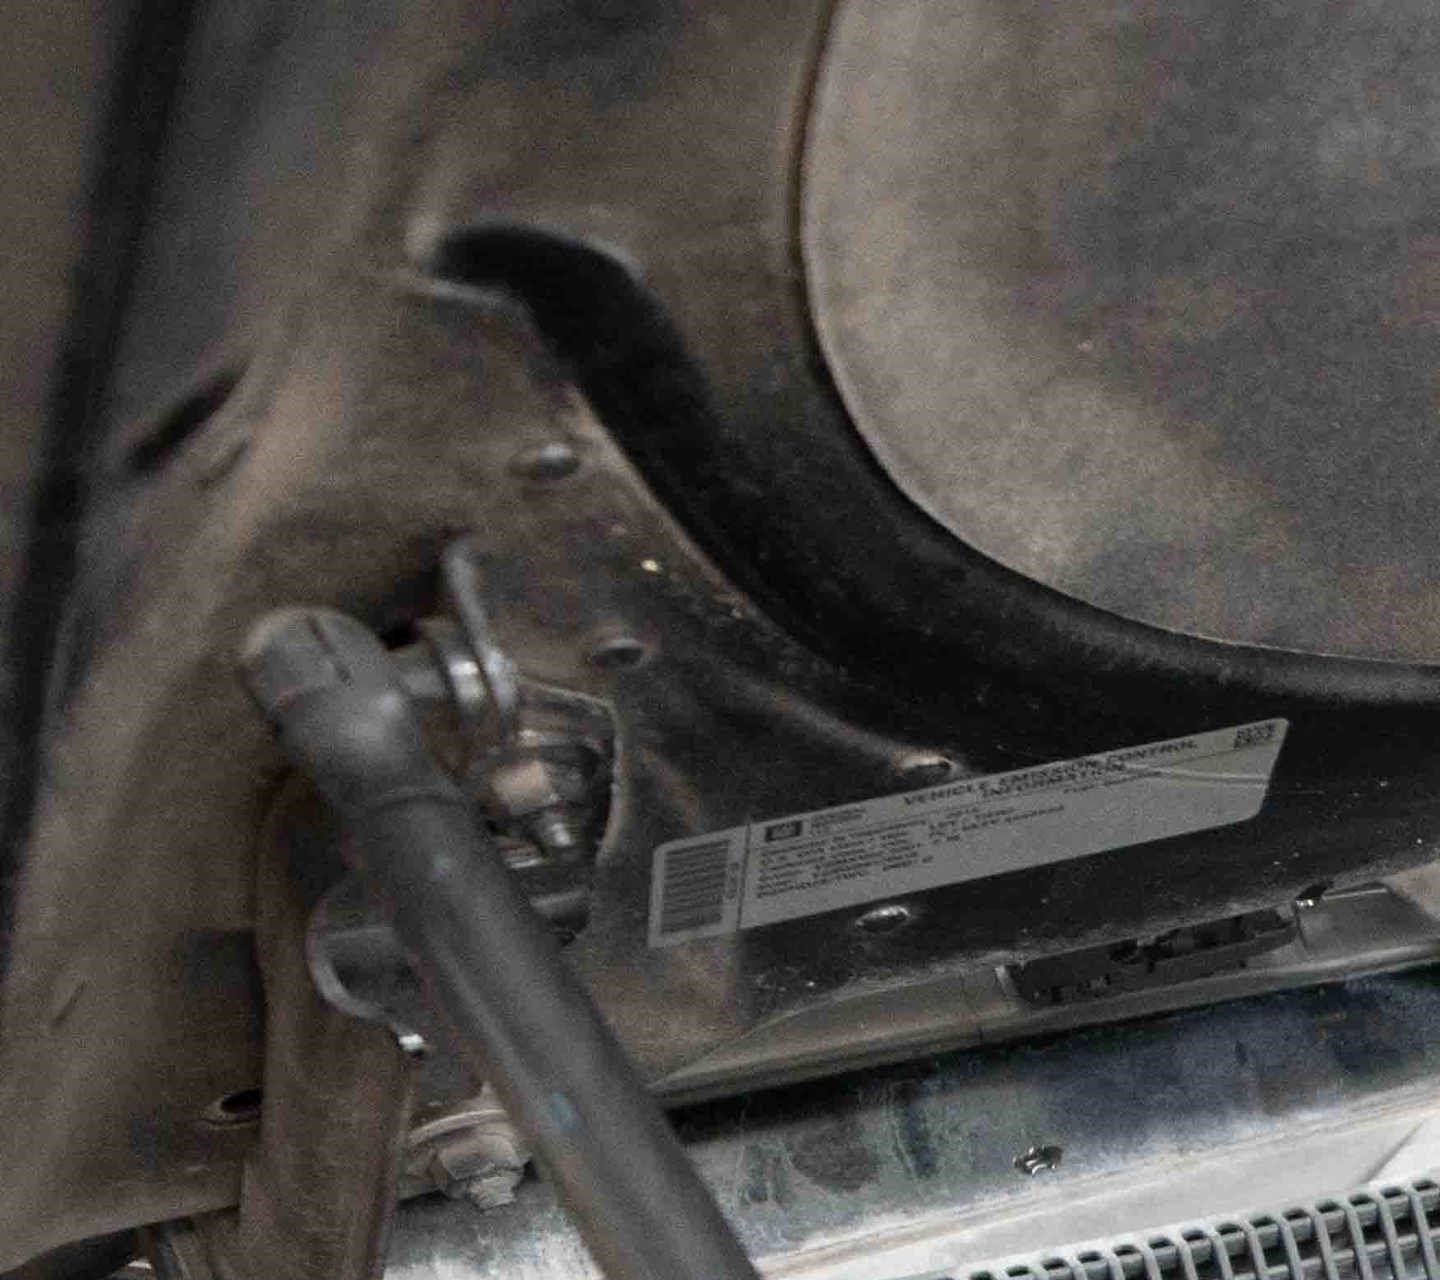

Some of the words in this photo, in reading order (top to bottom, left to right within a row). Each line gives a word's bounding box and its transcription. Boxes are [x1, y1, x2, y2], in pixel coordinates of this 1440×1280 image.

[903, 778, 988, 806] VEHICLE
[998, 758, 1100, 789] EMISSION
[1106, 738, 1196, 764] CONTROL
[979, 762, 1126, 798] INFORMATION
